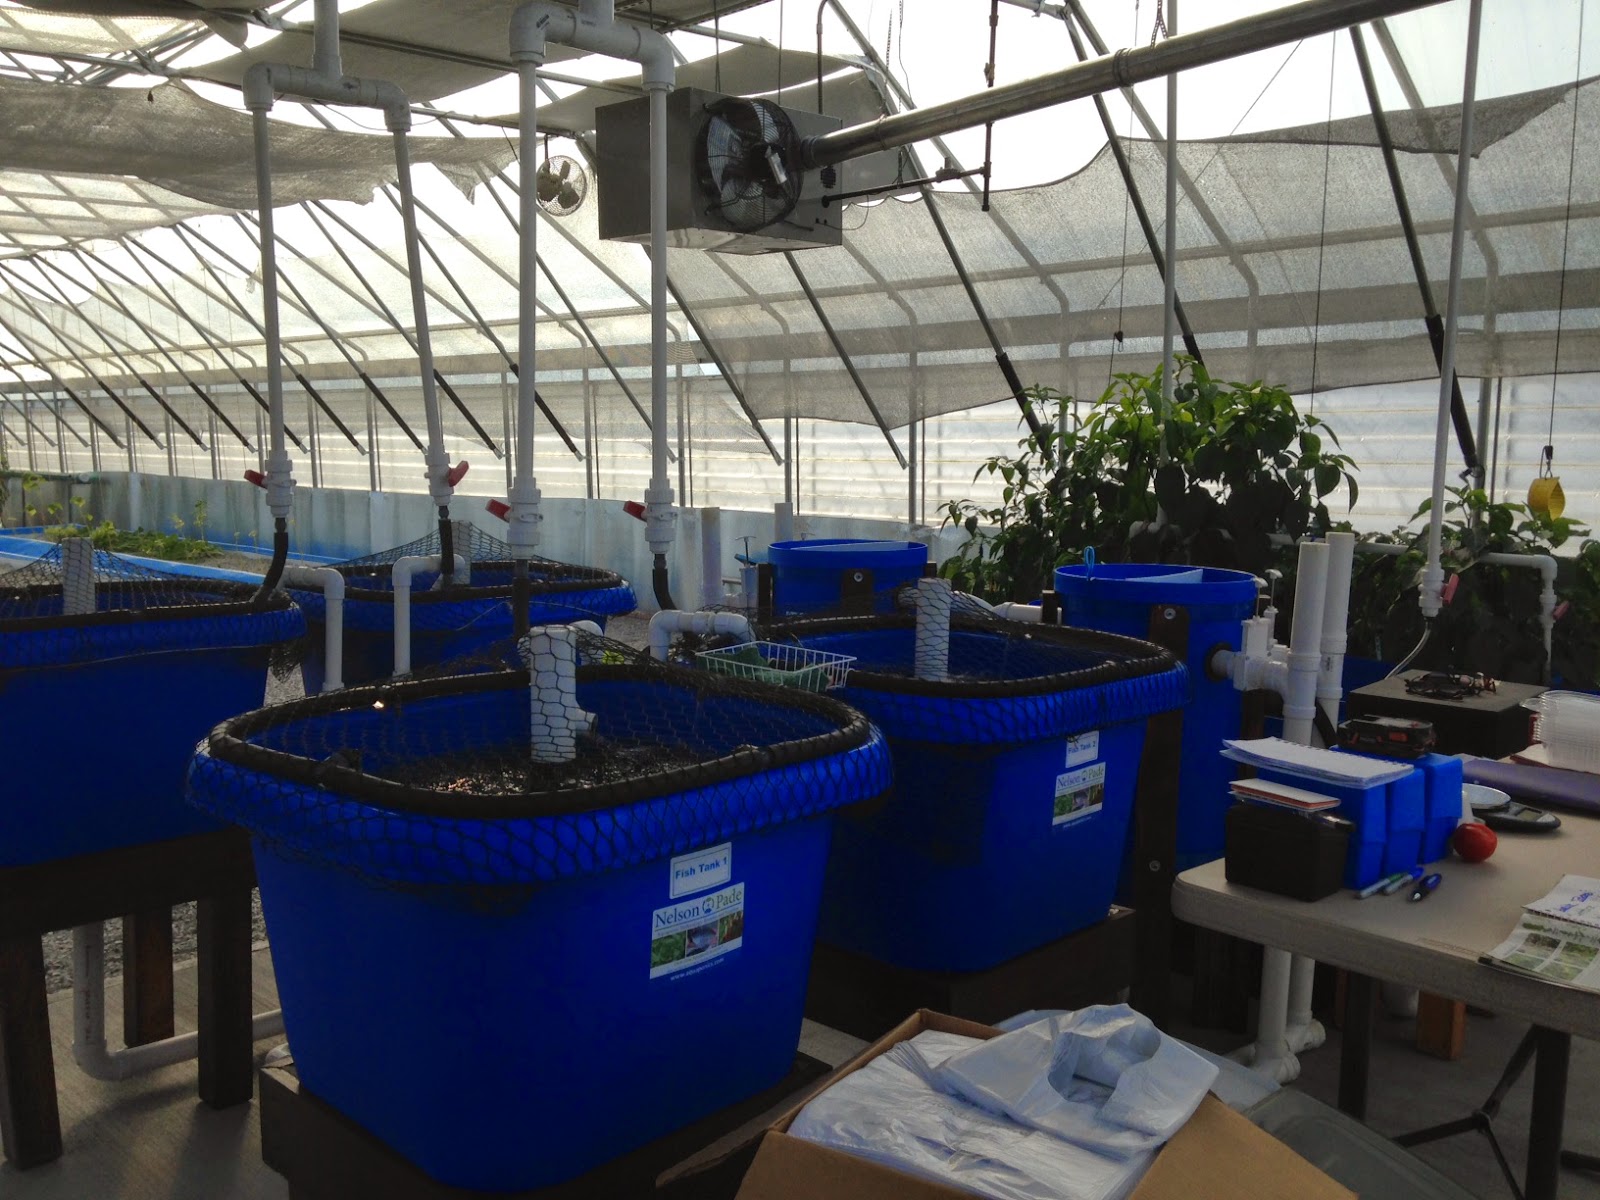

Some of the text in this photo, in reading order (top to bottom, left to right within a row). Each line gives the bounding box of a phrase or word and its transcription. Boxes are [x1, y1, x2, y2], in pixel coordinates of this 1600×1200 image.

[675, 856, 727, 880] Fish Tank 1
[655, 906, 700, 928] Nelson
[716, 888, 742, 909] Pade
